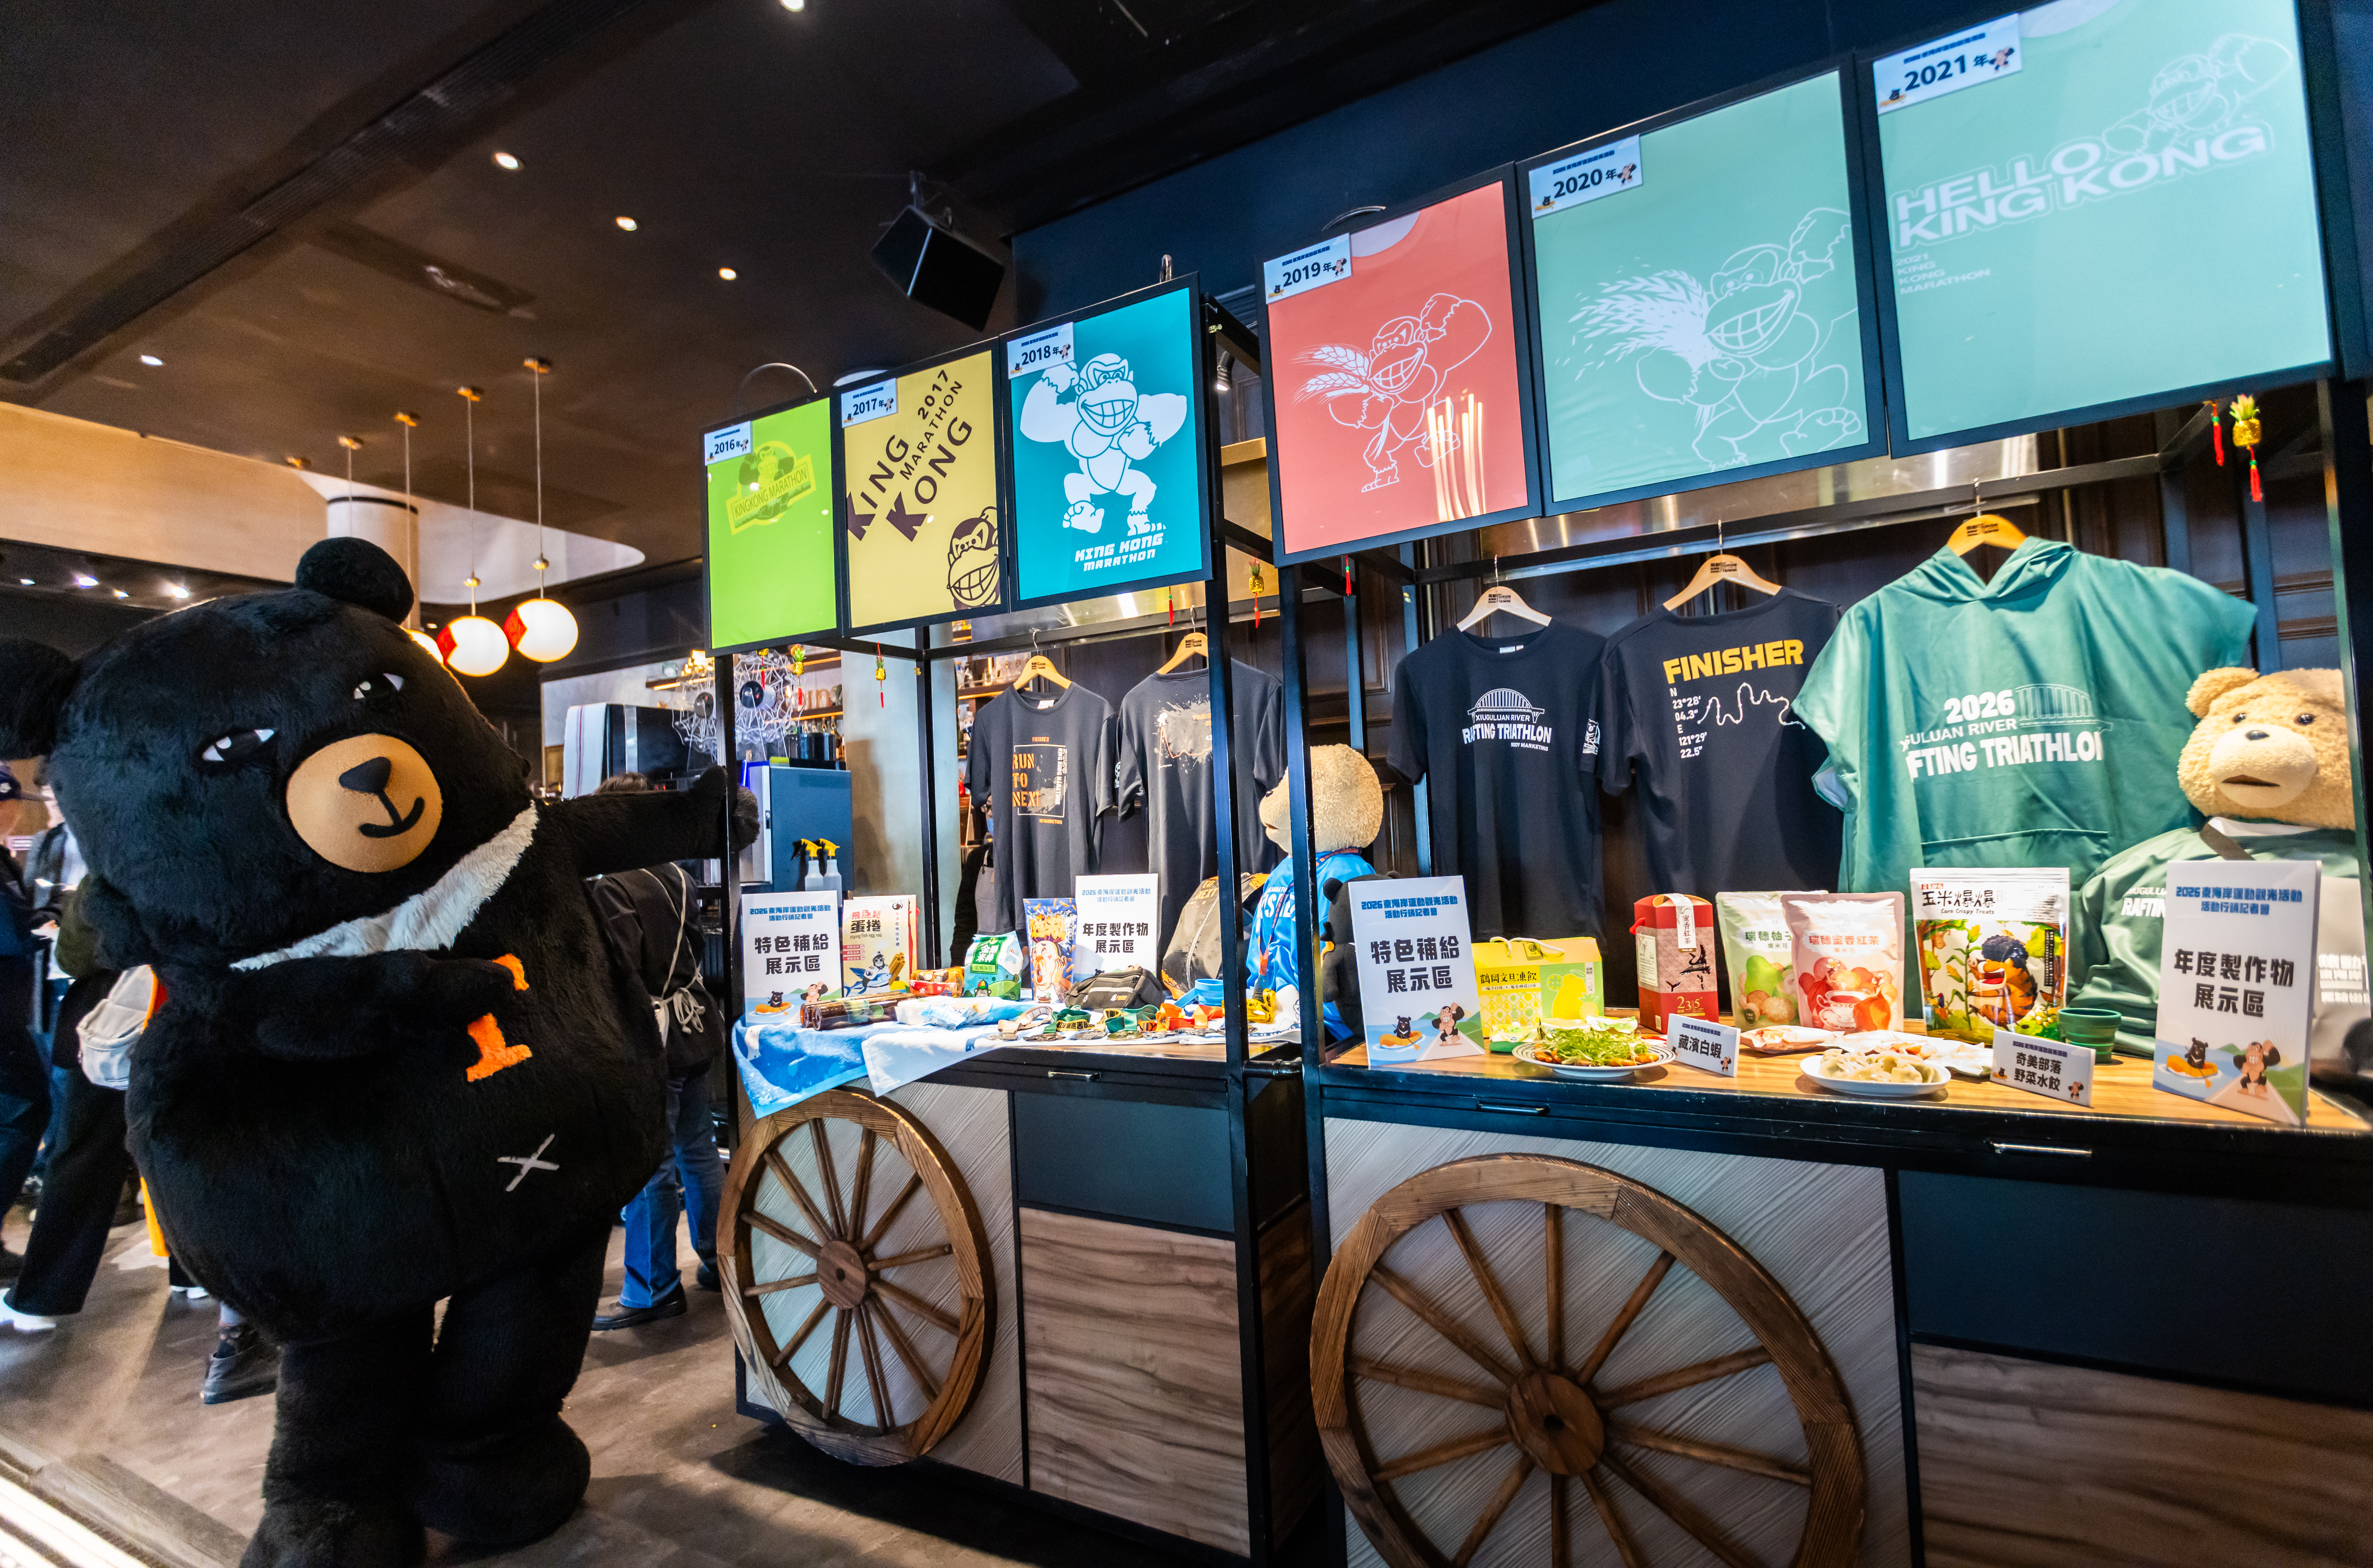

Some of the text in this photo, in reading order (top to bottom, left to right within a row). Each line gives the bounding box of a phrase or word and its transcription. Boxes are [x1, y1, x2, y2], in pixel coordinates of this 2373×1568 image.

[1897, 143, 2101, 220] HELLO
[1899, 127, 2266, 247] KING KONG
[1897, 261, 1936, 275] KING
[1899, 269, 1945, 285] KONG
[1900, 269, 1990, 295] MARATHON
[918, 369, 948, 420] 2017
[900, 381, 962, 480] MARATHON
[847, 434, 908, 541] KING
[886, 416, 972, 542] KONG
[734, 467, 807, 518] KINGKONG MARATHON
[1075, 532, 1164, 562] KING KONG
[1084, 548, 1156, 571] MARATHON
[1663, 639, 1804, 684] FINISHER
[1670, 687, 1677, 697] N
[1944, 690, 2015, 724] 2026
[1462, 723, 1552, 744] RAFTING TRIATHLON
[1677, 724, 1683, 734] E
[1968, 718, 2017, 736] RIVER
[1521, 742, 1549, 751] MARKETING
[1012, 753, 1034, 769] RUN
[1012, 772, 1028, 788] TO
[1012, 791, 1040, 807] NEXT
[1922, 890, 1996, 907] 玉米爆爆
[2120, 897, 2166, 918] RAFTIN
[850, 920, 881, 934] 蛋捲
[1083, 922, 1148, 936] 年度製作物
[1683, 915, 1692, 944] 蜜香紅茶
[755, 934, 829, 954] 特色補給
[1095, 940, 1134, 953] 展示區
[1371, 936, 1460, 964] 特色補給
[1809, 935, 1879, 945] 瑞穗蜜香紅茶
[766, 955, 820, 975] 展示區
[2174, 948, 2294, 987] 年度製作物
[1387, 965, 1452, 993] 展示區
[1480, 971, 1537, 984] 鶴岡文旦凍飲
[2193, 982, 2265, 1018] 展示區
[1678, 1034, 1722, 1059] 藏濱白蝦
[2016, 1052, 2061, 1075] 奇美部落
[2014, 1068, 2060, 1091] 野菜水餃
